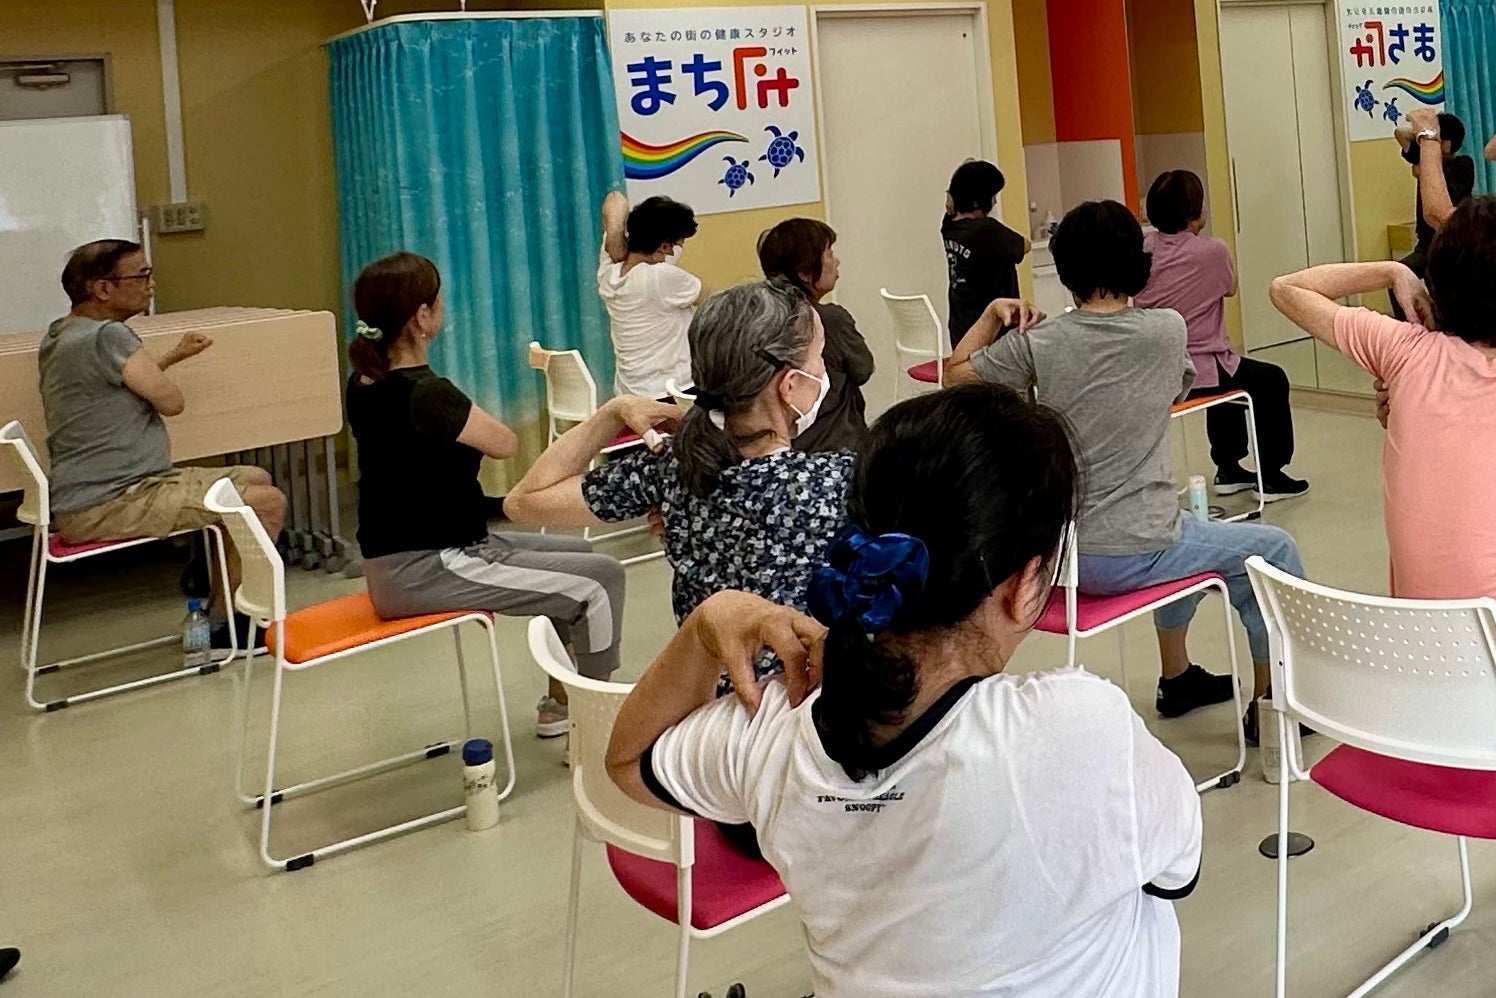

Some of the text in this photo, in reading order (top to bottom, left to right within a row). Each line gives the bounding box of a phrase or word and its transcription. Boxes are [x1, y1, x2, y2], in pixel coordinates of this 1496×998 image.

[624, 26, 796, 43] あなたの街の健康スタジオ
[769, 46, 798, 56] フィット
